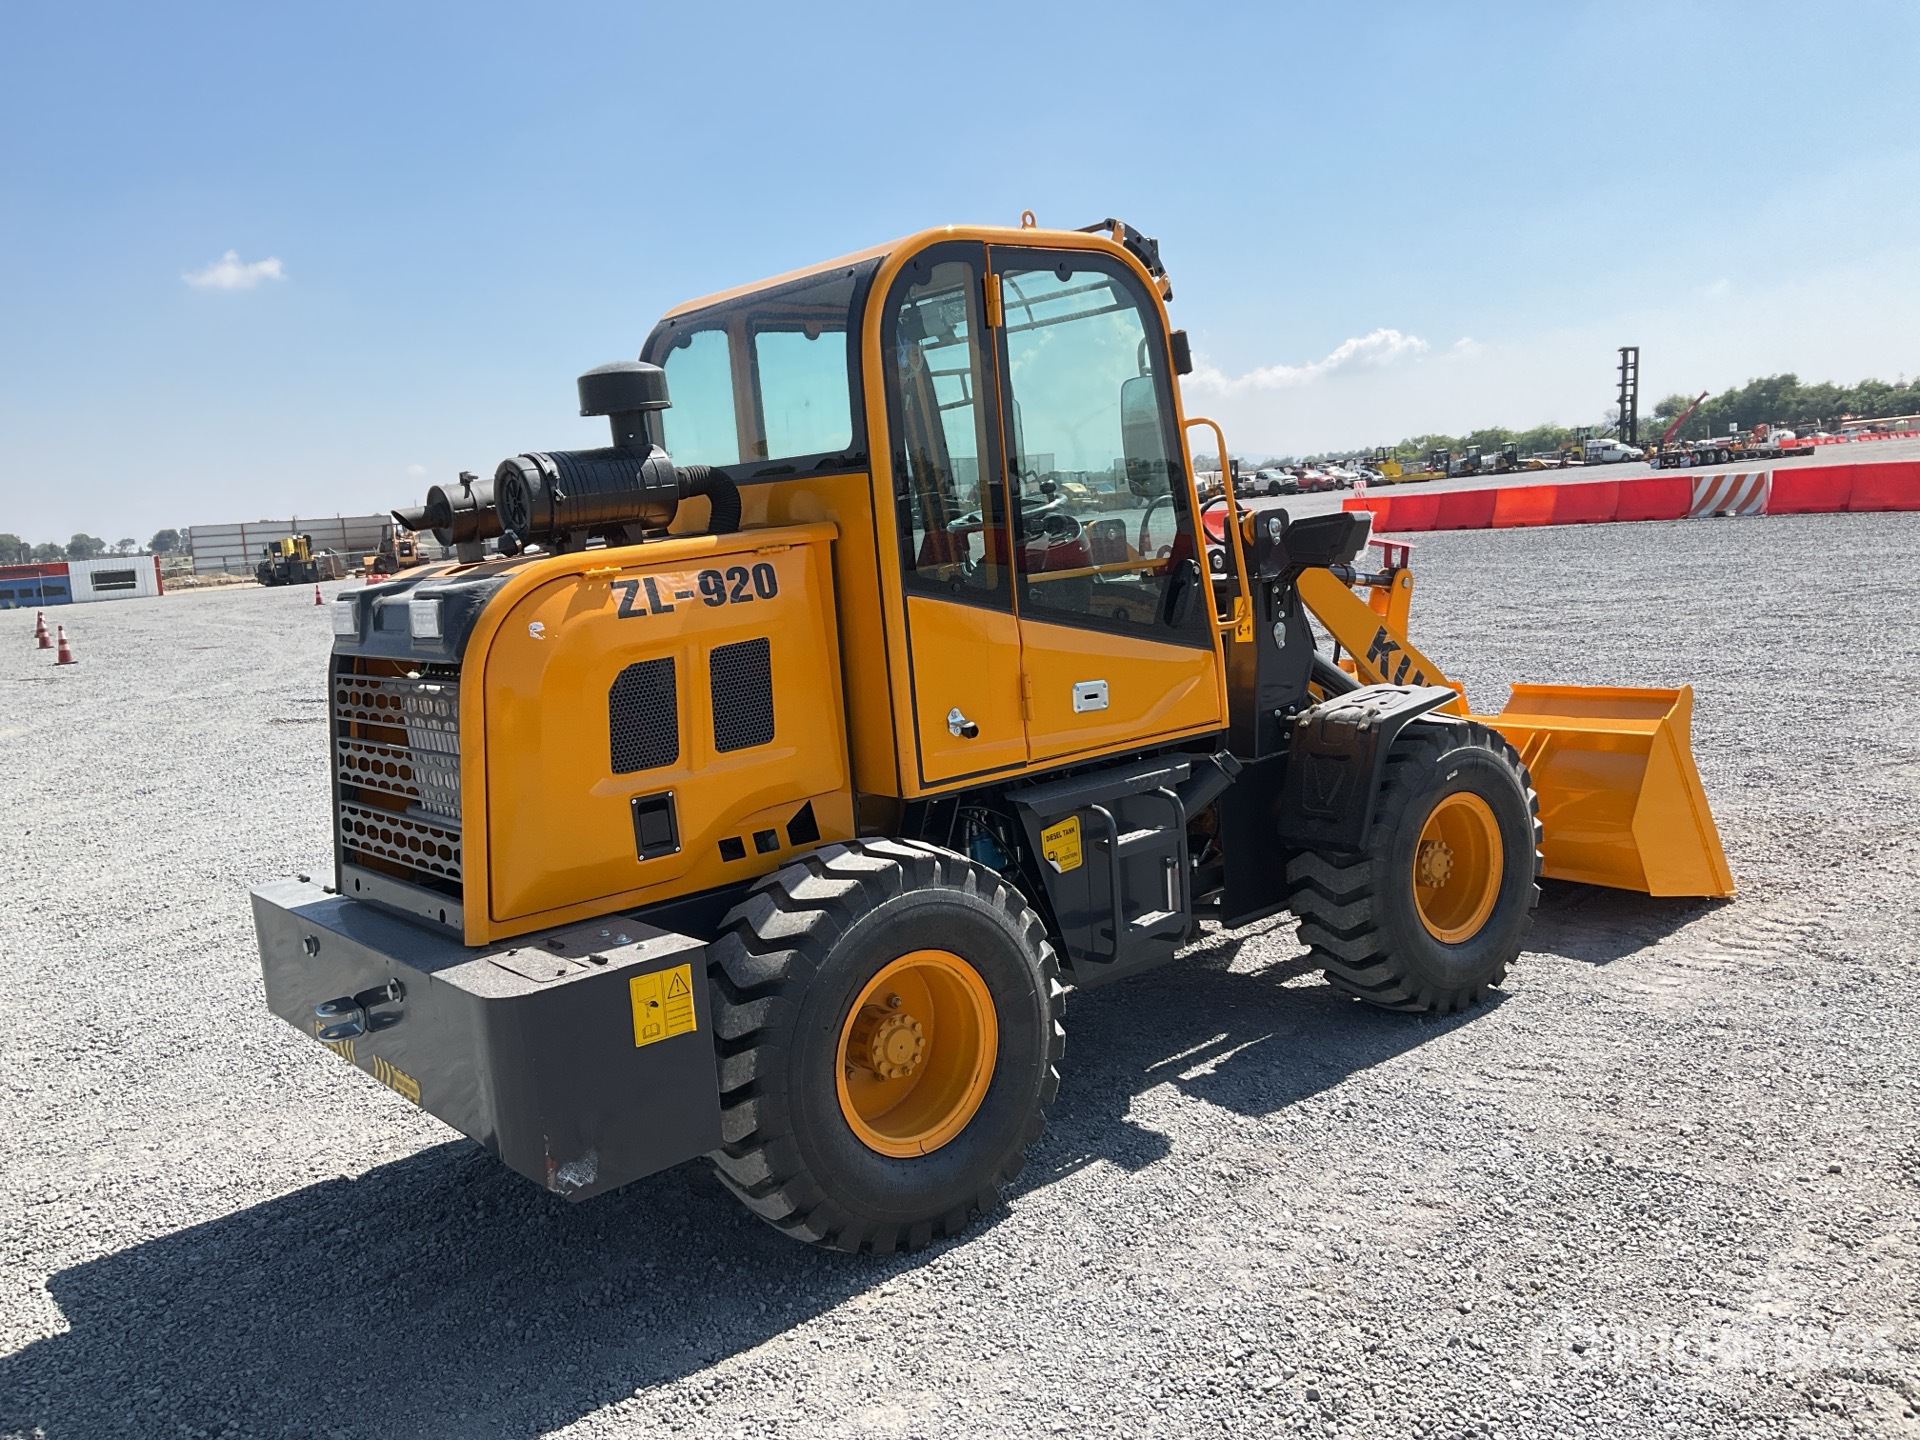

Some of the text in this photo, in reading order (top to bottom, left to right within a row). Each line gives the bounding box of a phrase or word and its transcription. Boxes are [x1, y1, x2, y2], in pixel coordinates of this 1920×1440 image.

[610, 562, 778, 619] ZL-920
[1046, 826, 1075, 842] DIESEL TANK
